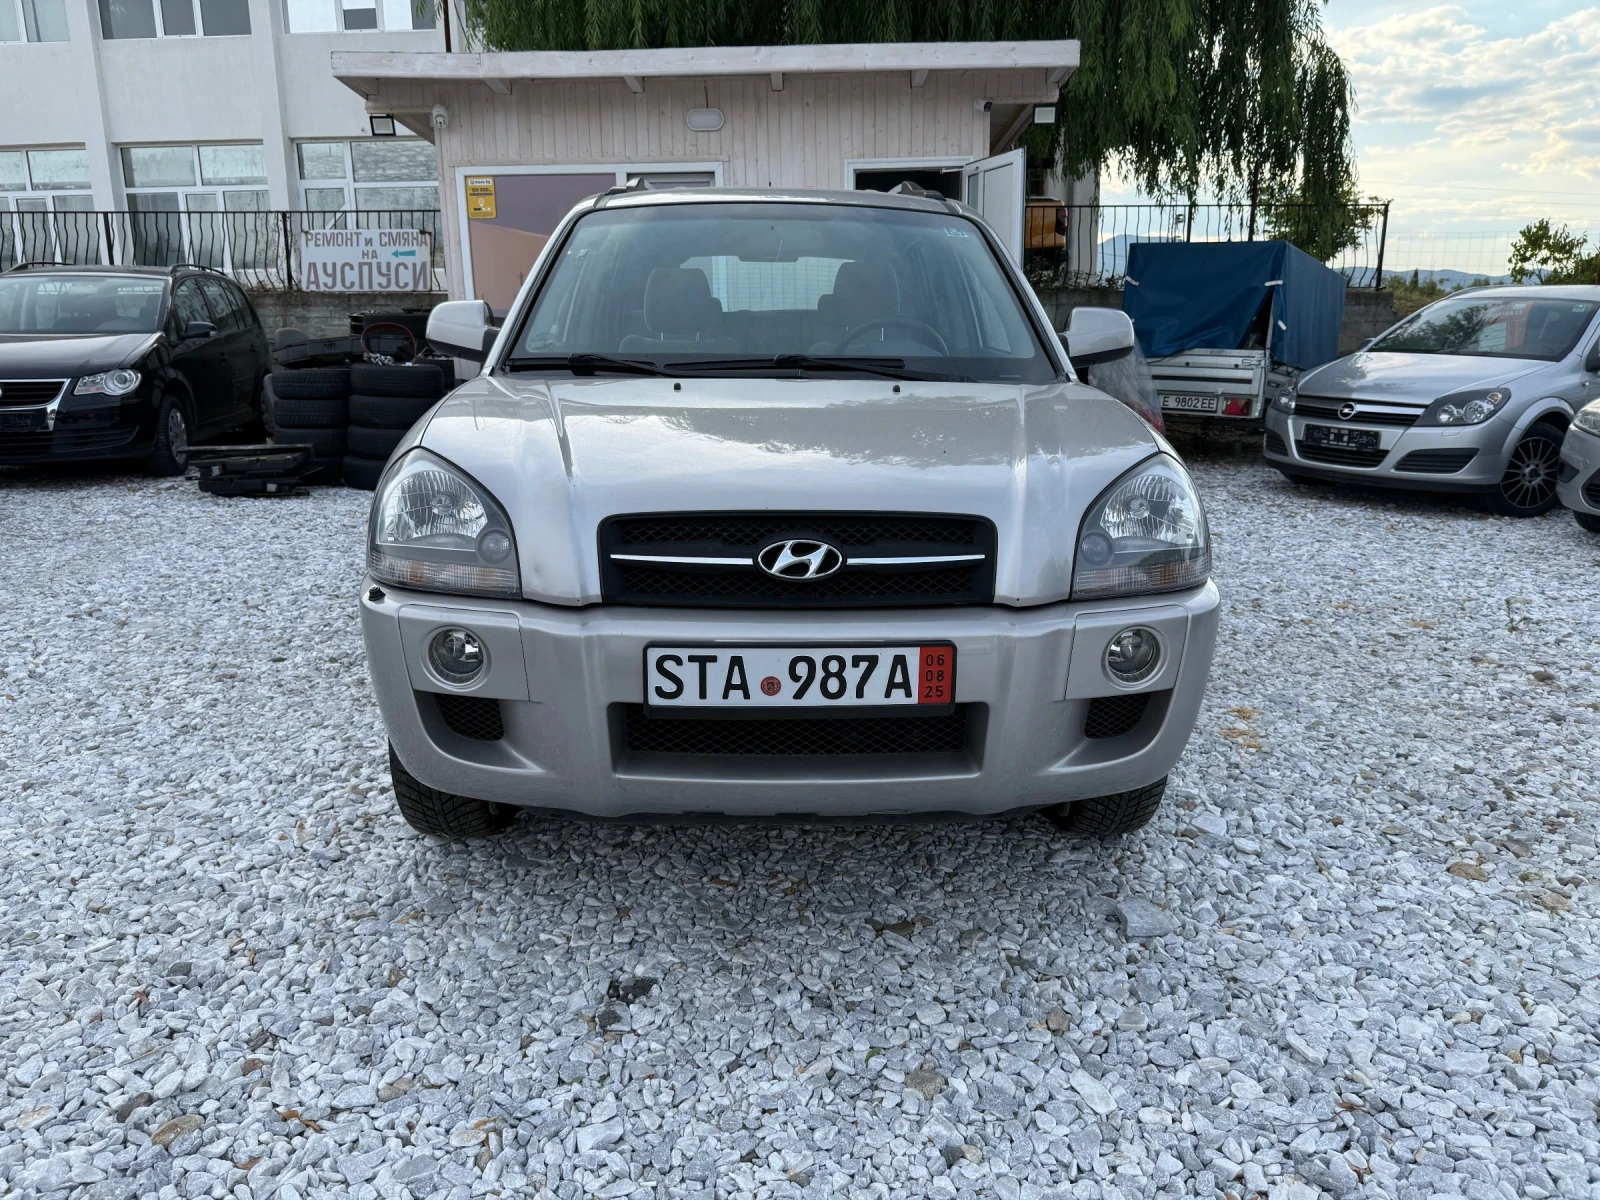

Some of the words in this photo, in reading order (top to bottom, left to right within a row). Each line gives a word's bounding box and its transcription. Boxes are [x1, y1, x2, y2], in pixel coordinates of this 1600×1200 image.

[305, 232, 361, 247] РЕМОНТ
[379, 231, 428, 247] СМЯНА
[361, 250, 378, 260] НА
[305, 261, 429, 290] АУСПУСИ
[926, 653, 944, 666] 06
[655, 655, 750, 699] STA
[788, 655, 913, 699] 987A
[925, 669, 944, 682] 08
[924, 685, 944, 698] 25
